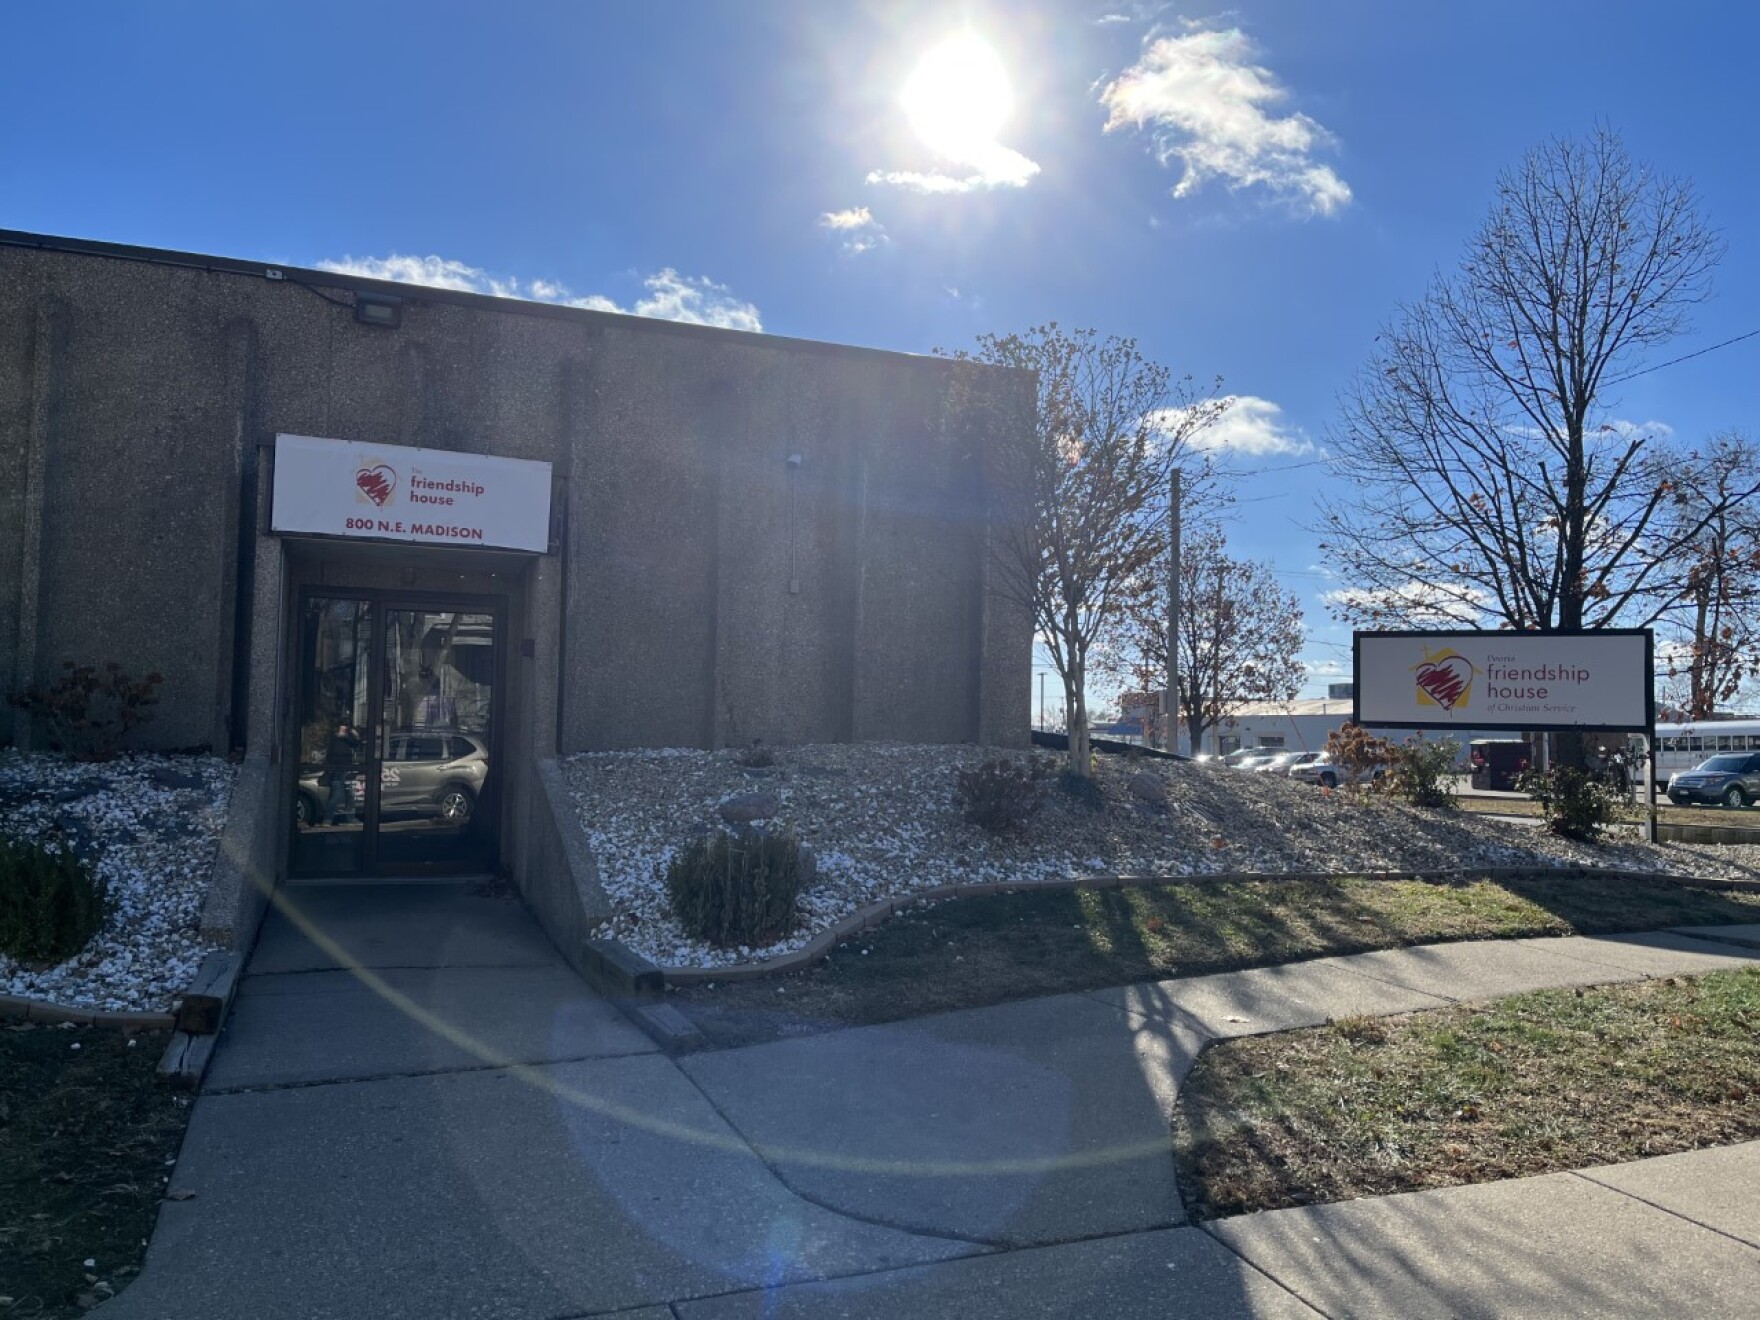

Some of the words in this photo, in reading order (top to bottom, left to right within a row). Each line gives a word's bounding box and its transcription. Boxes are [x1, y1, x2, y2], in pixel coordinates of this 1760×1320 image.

[411, 475, 485, 496] friendship
[411, 491, 454, 506] house
[346, 518, 374, 530] 800
[378, 521, 406, 533] N.E.
[411, 524, 482, 540] MADISON
[1488, 664, 1590, 685] friendship
[1488, 682, 1548, 699] house
[1487, 704, 1496, 713] of
[1497, 704, 1540, 712] Christian
[1542, 704, 1577, 712] Service
